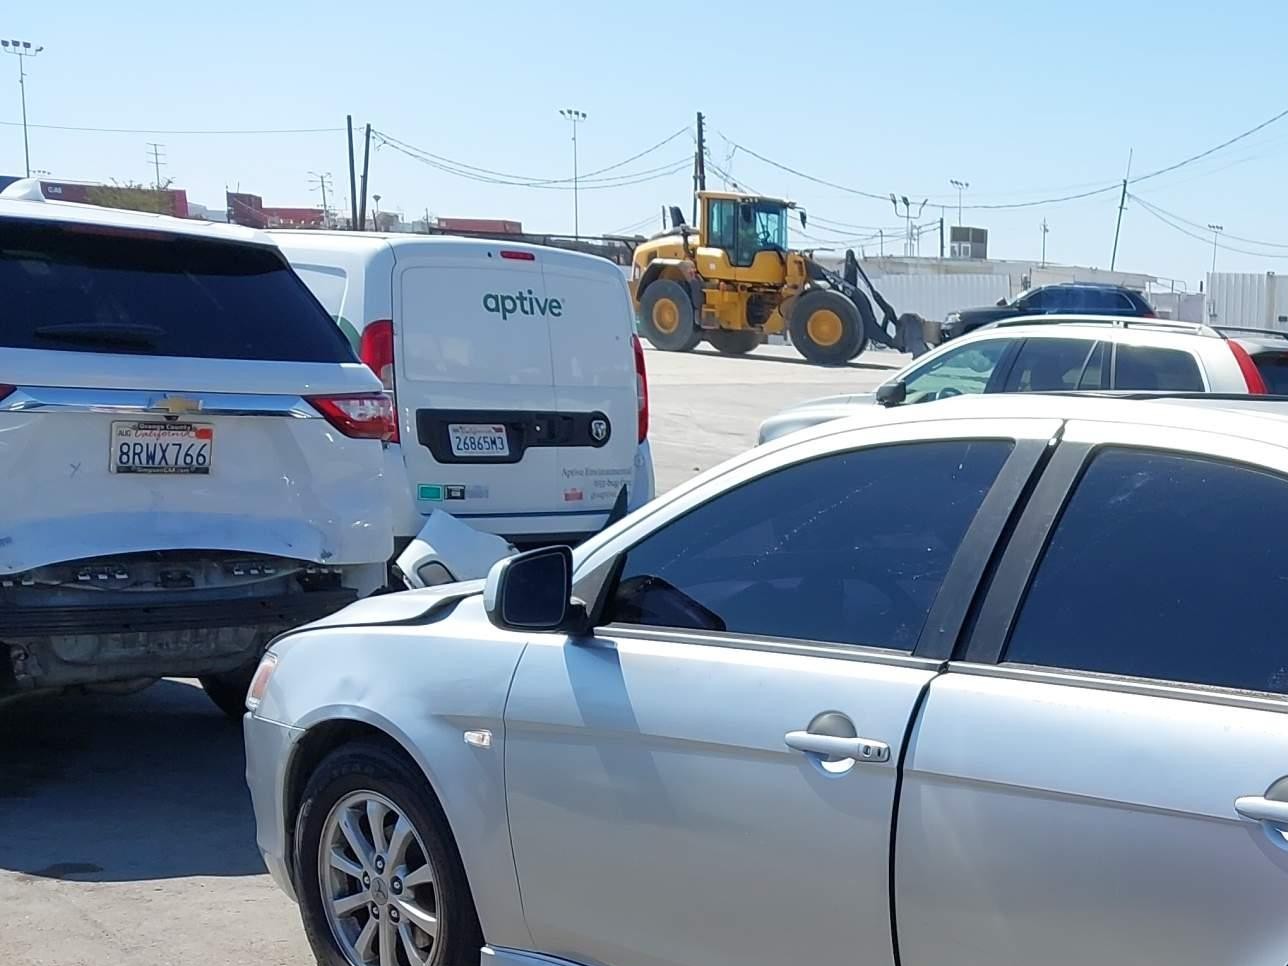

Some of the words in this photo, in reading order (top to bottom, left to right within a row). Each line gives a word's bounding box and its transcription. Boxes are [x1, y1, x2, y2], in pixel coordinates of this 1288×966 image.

[483, 289, 562, 320] aptive
[119, 442, 207, 465] 8RWX766
[455, 436, 505, 451] 26865M3
